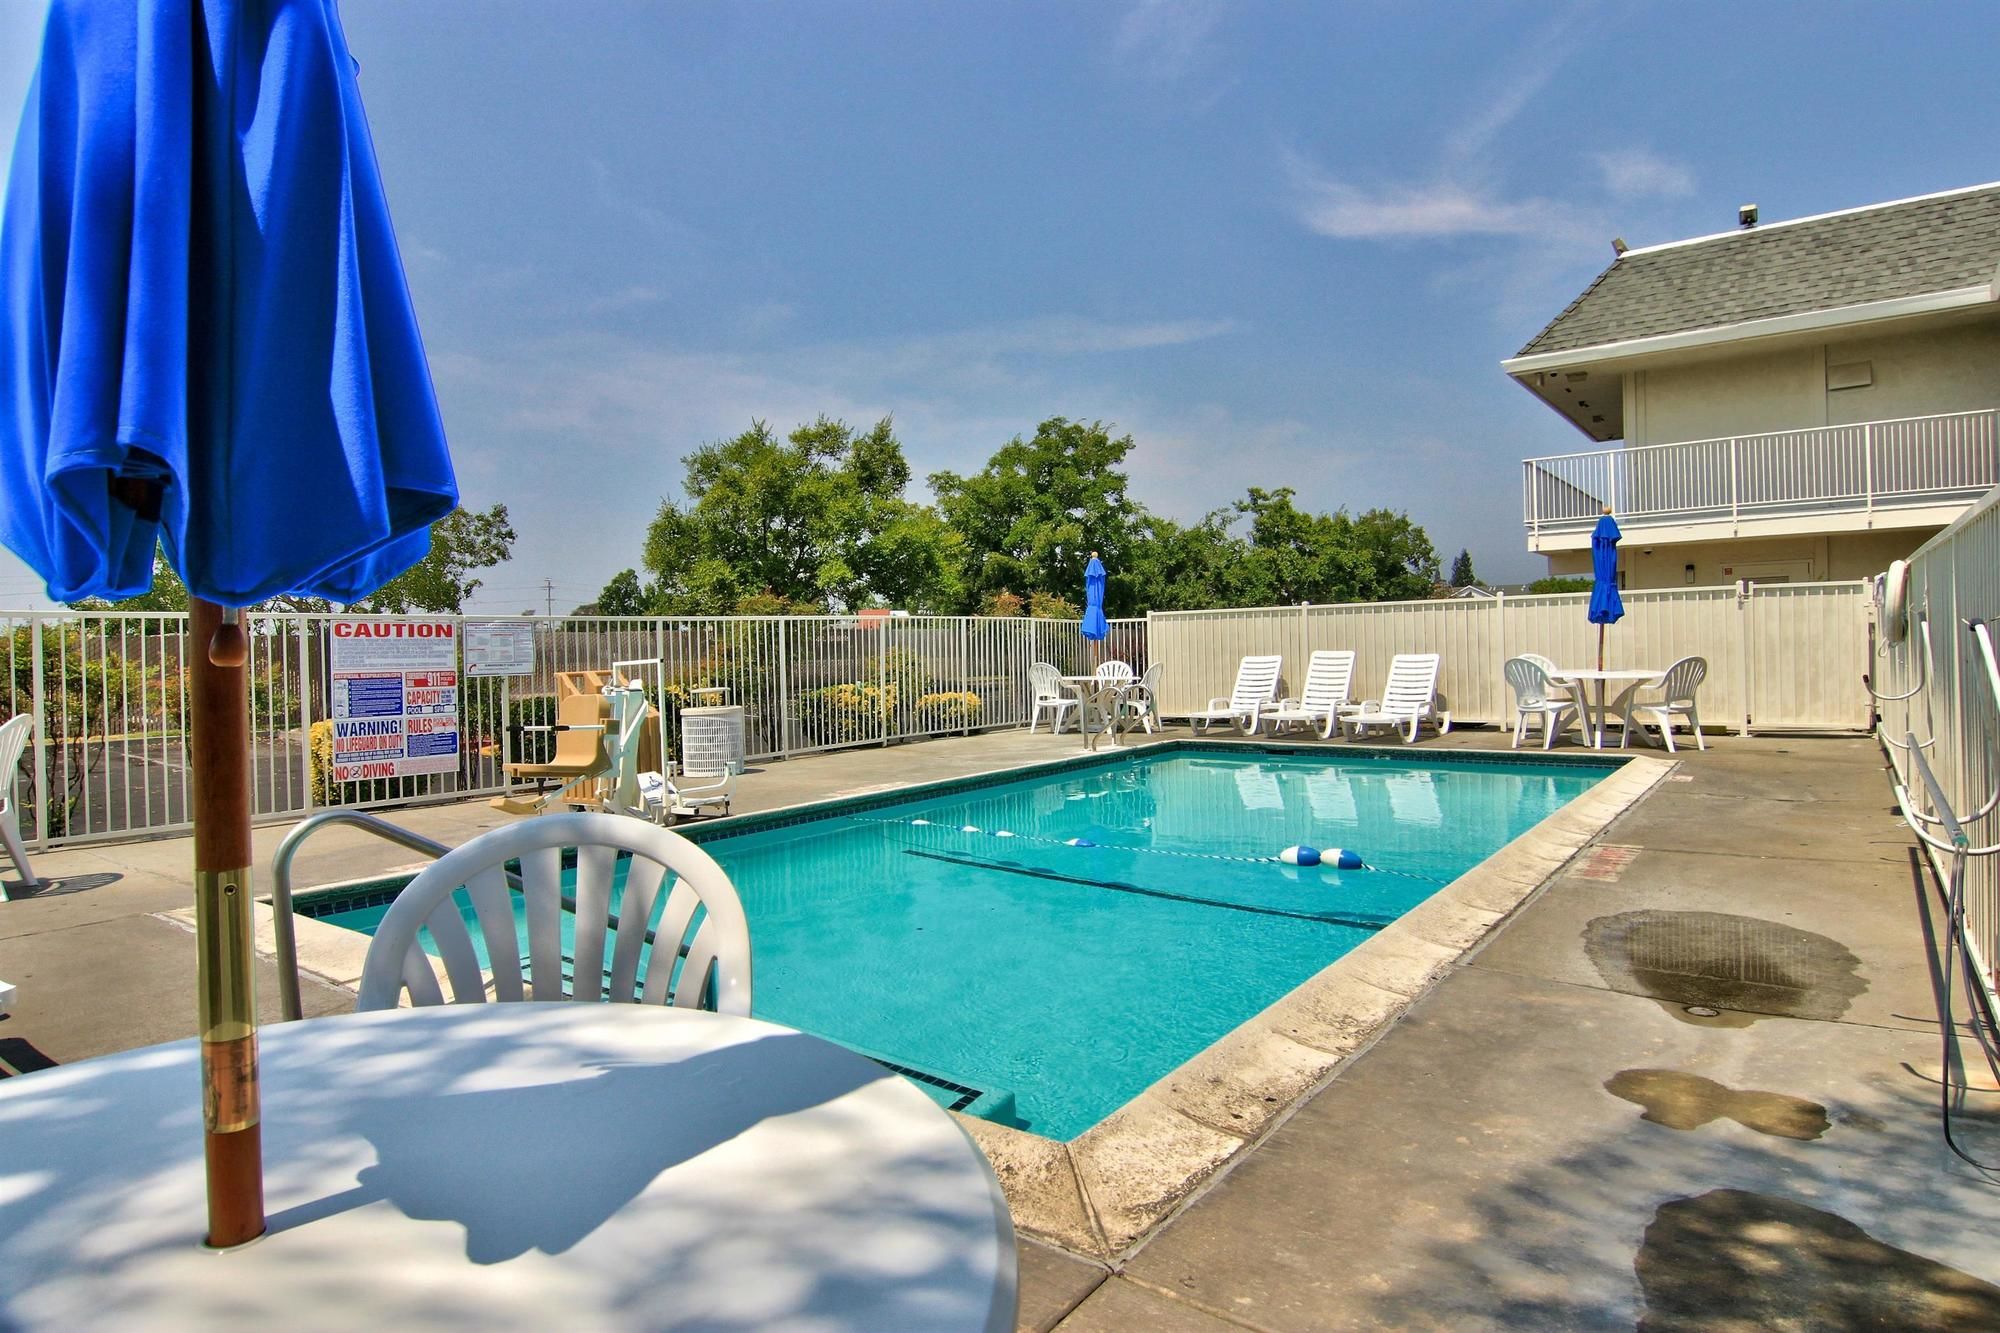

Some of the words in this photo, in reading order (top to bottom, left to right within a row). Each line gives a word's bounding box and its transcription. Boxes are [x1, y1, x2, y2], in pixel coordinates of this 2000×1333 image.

[334, 623, 453, 638] CAUTION
[428, 672, 440, 686] 911
[407, 690, 440, 705] CAPACITY
[336, 720, 402, 737] WARNING!
[408, 719, 433, 733] RULES
[336, 738, 344, 752] NO
[346, 736, 377, 751] LIFEGUARD
[379, 735, 387, 749] ON
[389, 734, 402, 748] DUTY
[335, 766, 349, 780] NO
[363, 762, 395, 778] DIVING
